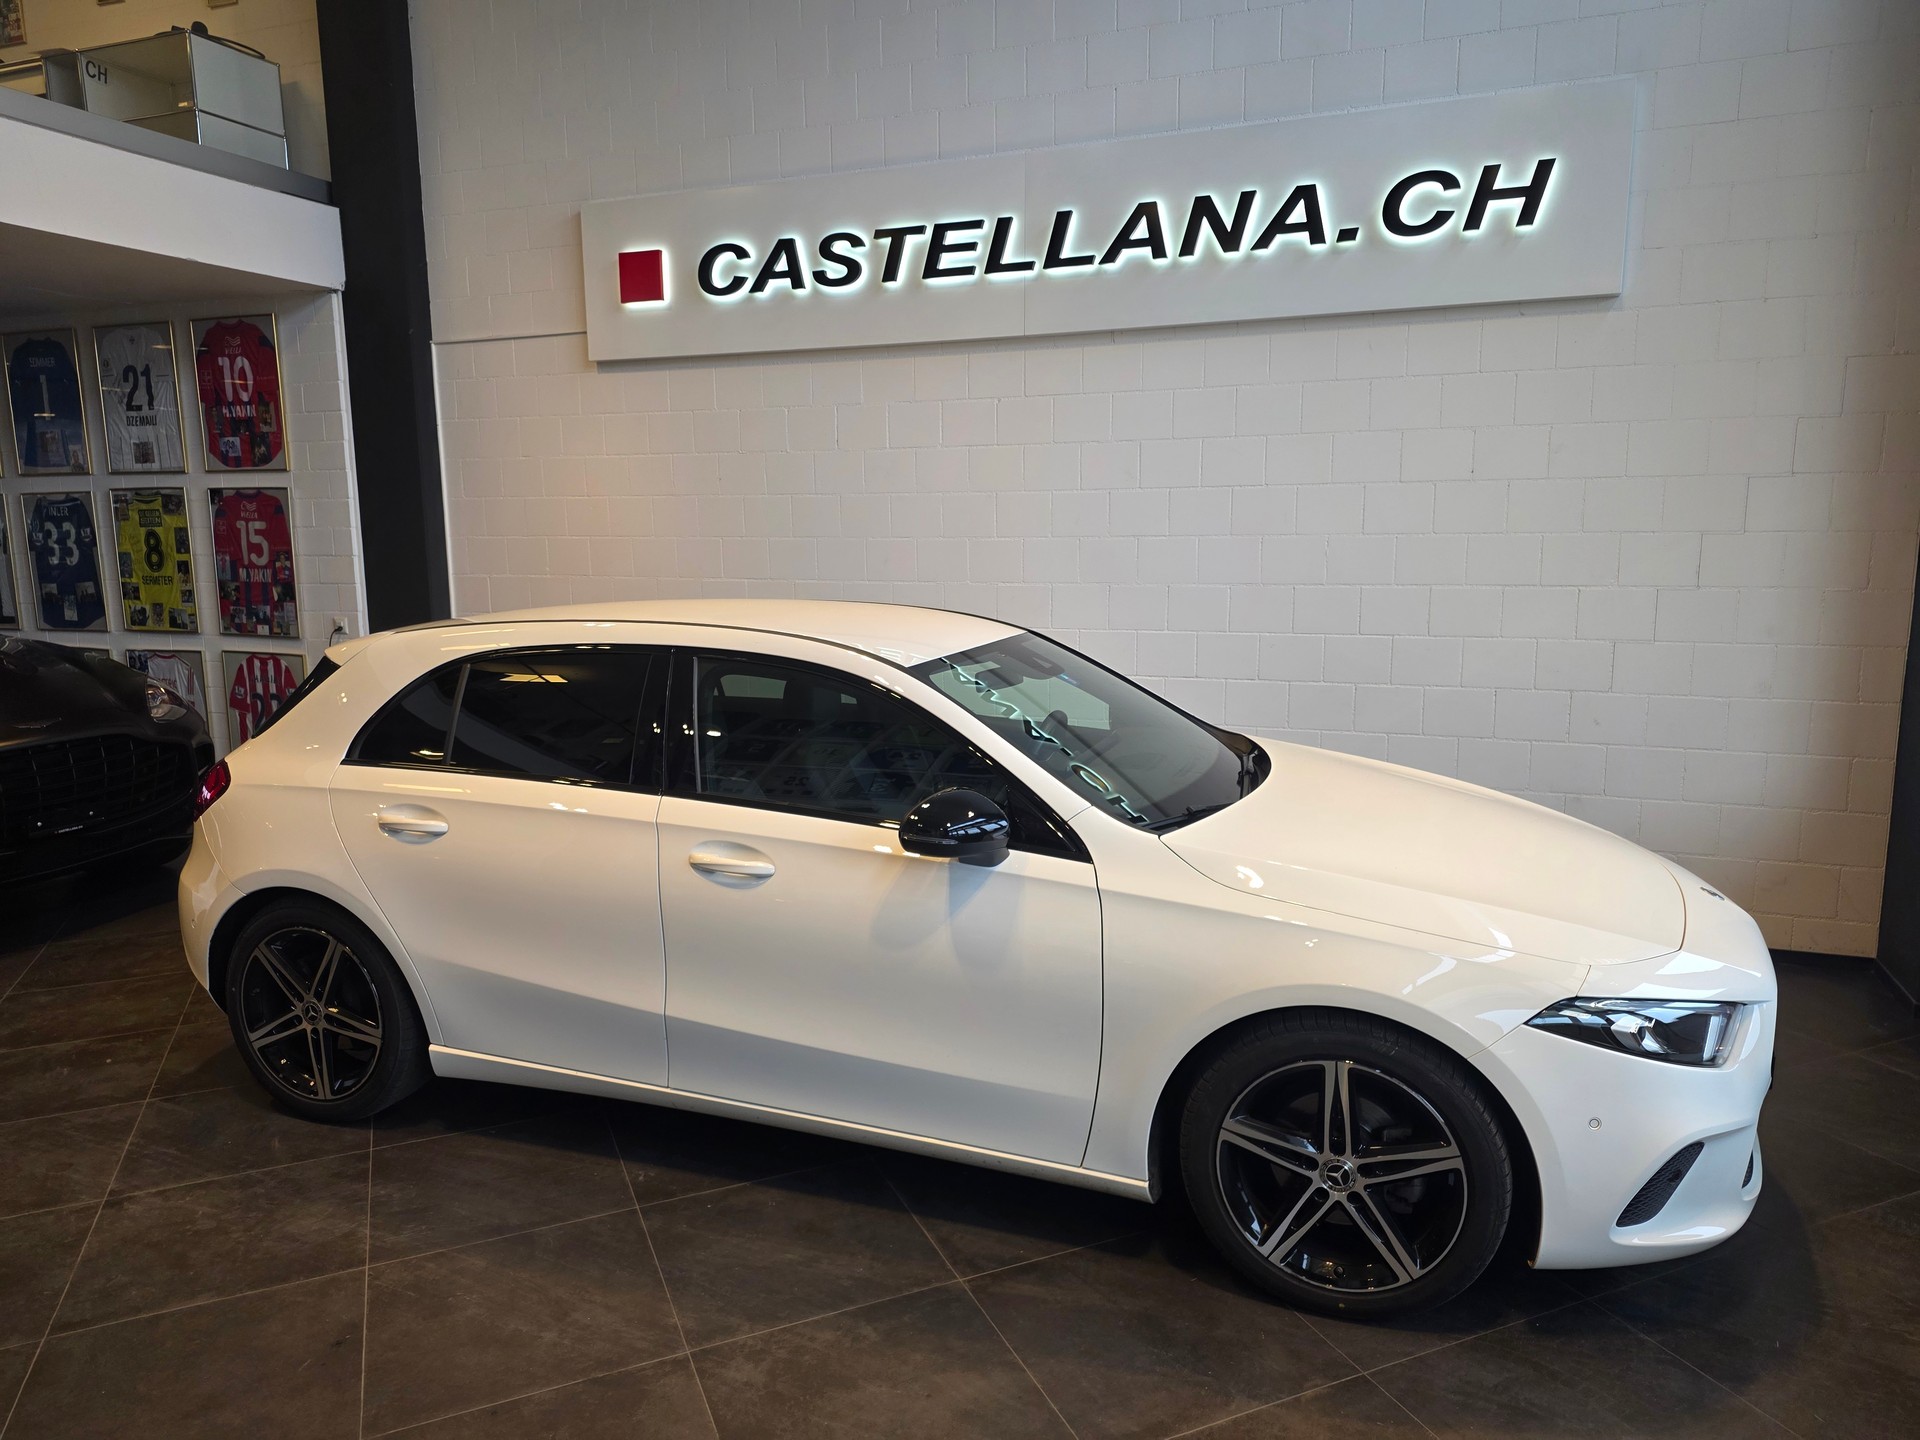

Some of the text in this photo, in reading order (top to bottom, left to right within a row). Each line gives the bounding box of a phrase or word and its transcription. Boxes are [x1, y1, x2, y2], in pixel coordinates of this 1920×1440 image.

[85, 60, 108, 85] CH
[696, 157, 1558, 297] CASTELLANA.CH
[123, 363, 155, 412] 21
[218, 356, 254, 402] 10
[44, 521, 79, 566] 33
[144, 528, 165, 573] 8
[236, 520, 270, 567] 15
